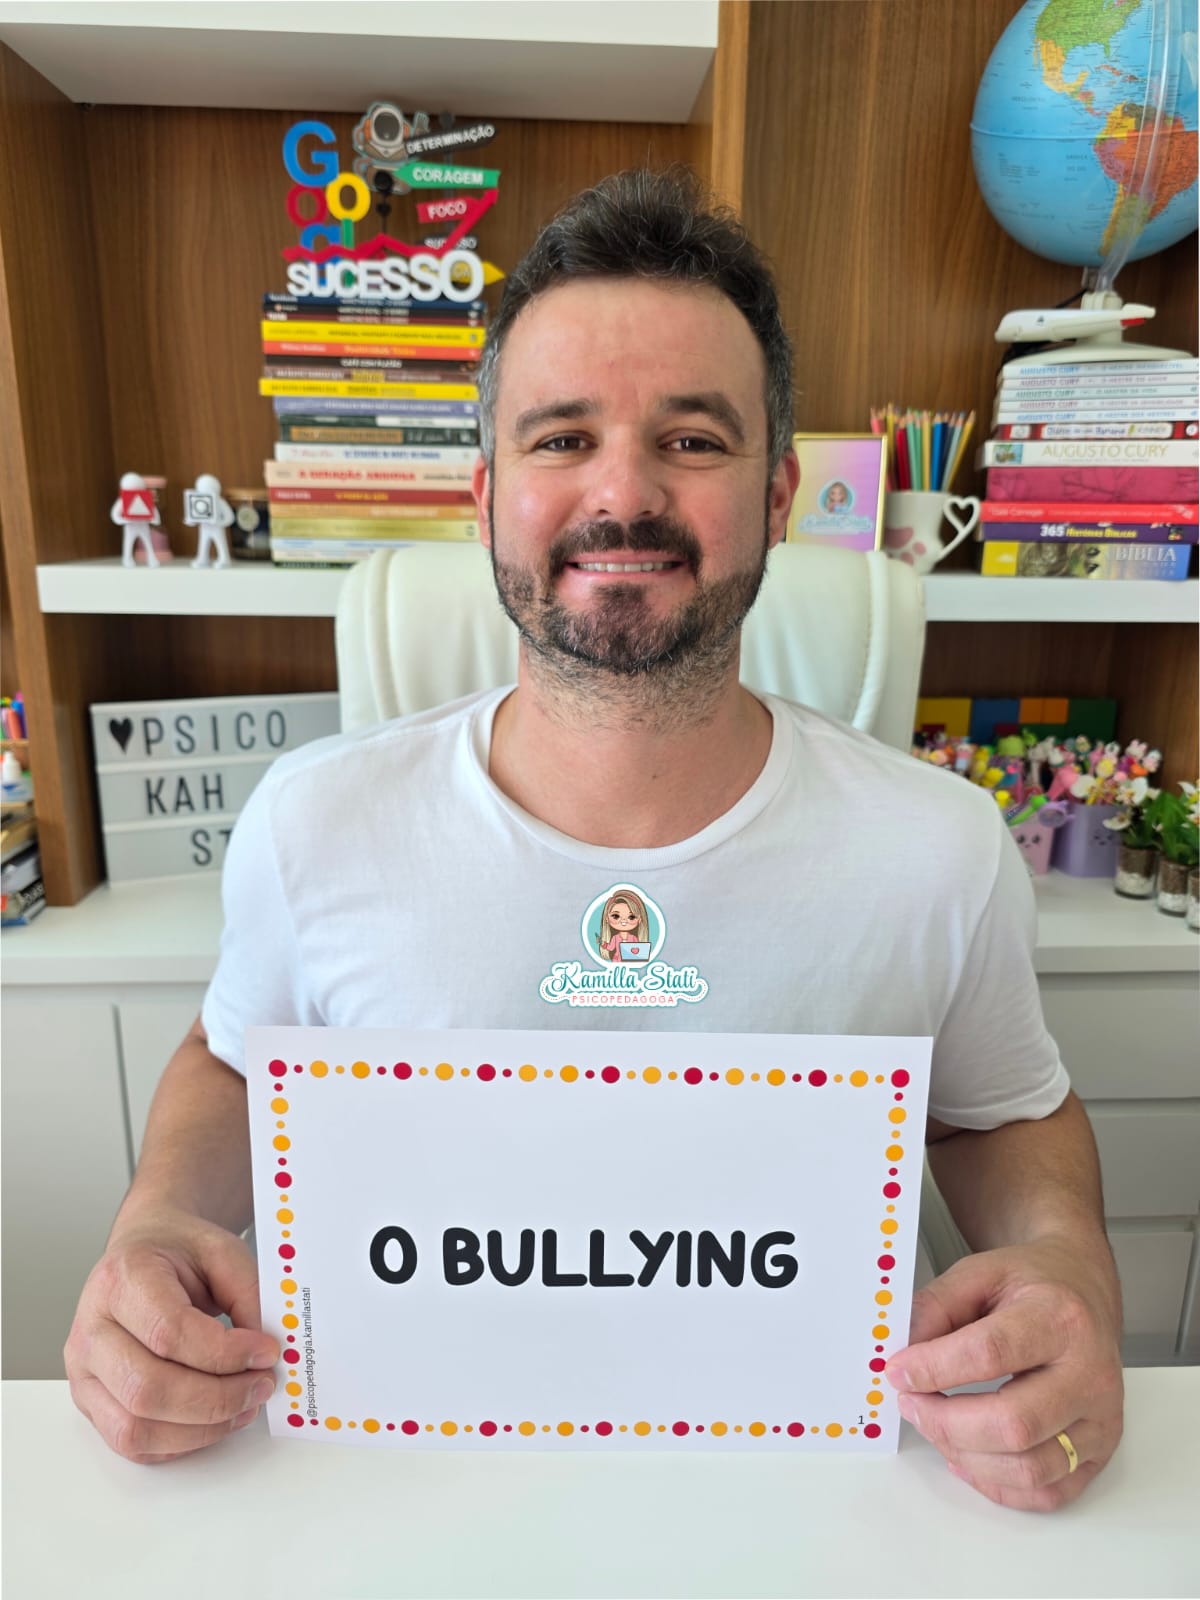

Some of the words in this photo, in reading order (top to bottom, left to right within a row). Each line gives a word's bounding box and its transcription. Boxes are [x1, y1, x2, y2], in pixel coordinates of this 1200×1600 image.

[406, 124, 496, 155] DETERMINAÇÃO
[411, 167, 484, 187] CORAGEM
[426, 200, 468, 220] FOCO
[286, 250, 485, 302] SUCESSO
[1020, 367, 1056, 376] AUGUSTO
[1059, 365, 1081, 374] CURY
[1020, 379, 1057, 387] AUGUSTO
[1059, 377, 1080, 386] CURY
[1016, 390, 1052, 399] AUGUSTO
[1054, 389, 1075, 397] CURY
[1016, 413, 1053, 421] AUGUSTO
[1055, 412, 1076, 420] CURY
[1041, 444, 1120, 458] AUGUSTO
[1124, 444, 1169, 458] CURY
[1040, 524, 1065, 537] 365
[142, 711, 286, 756] PSICO
[145, 774, 224, 815] KAH
[369, 1226, 418, 1285] O
[442, 1227, 799, 1289] BULLYING
[302, 1287, 318, 1418] @psicopedagogia.kamillastati
[857, 1415, 865, 1425] 1
